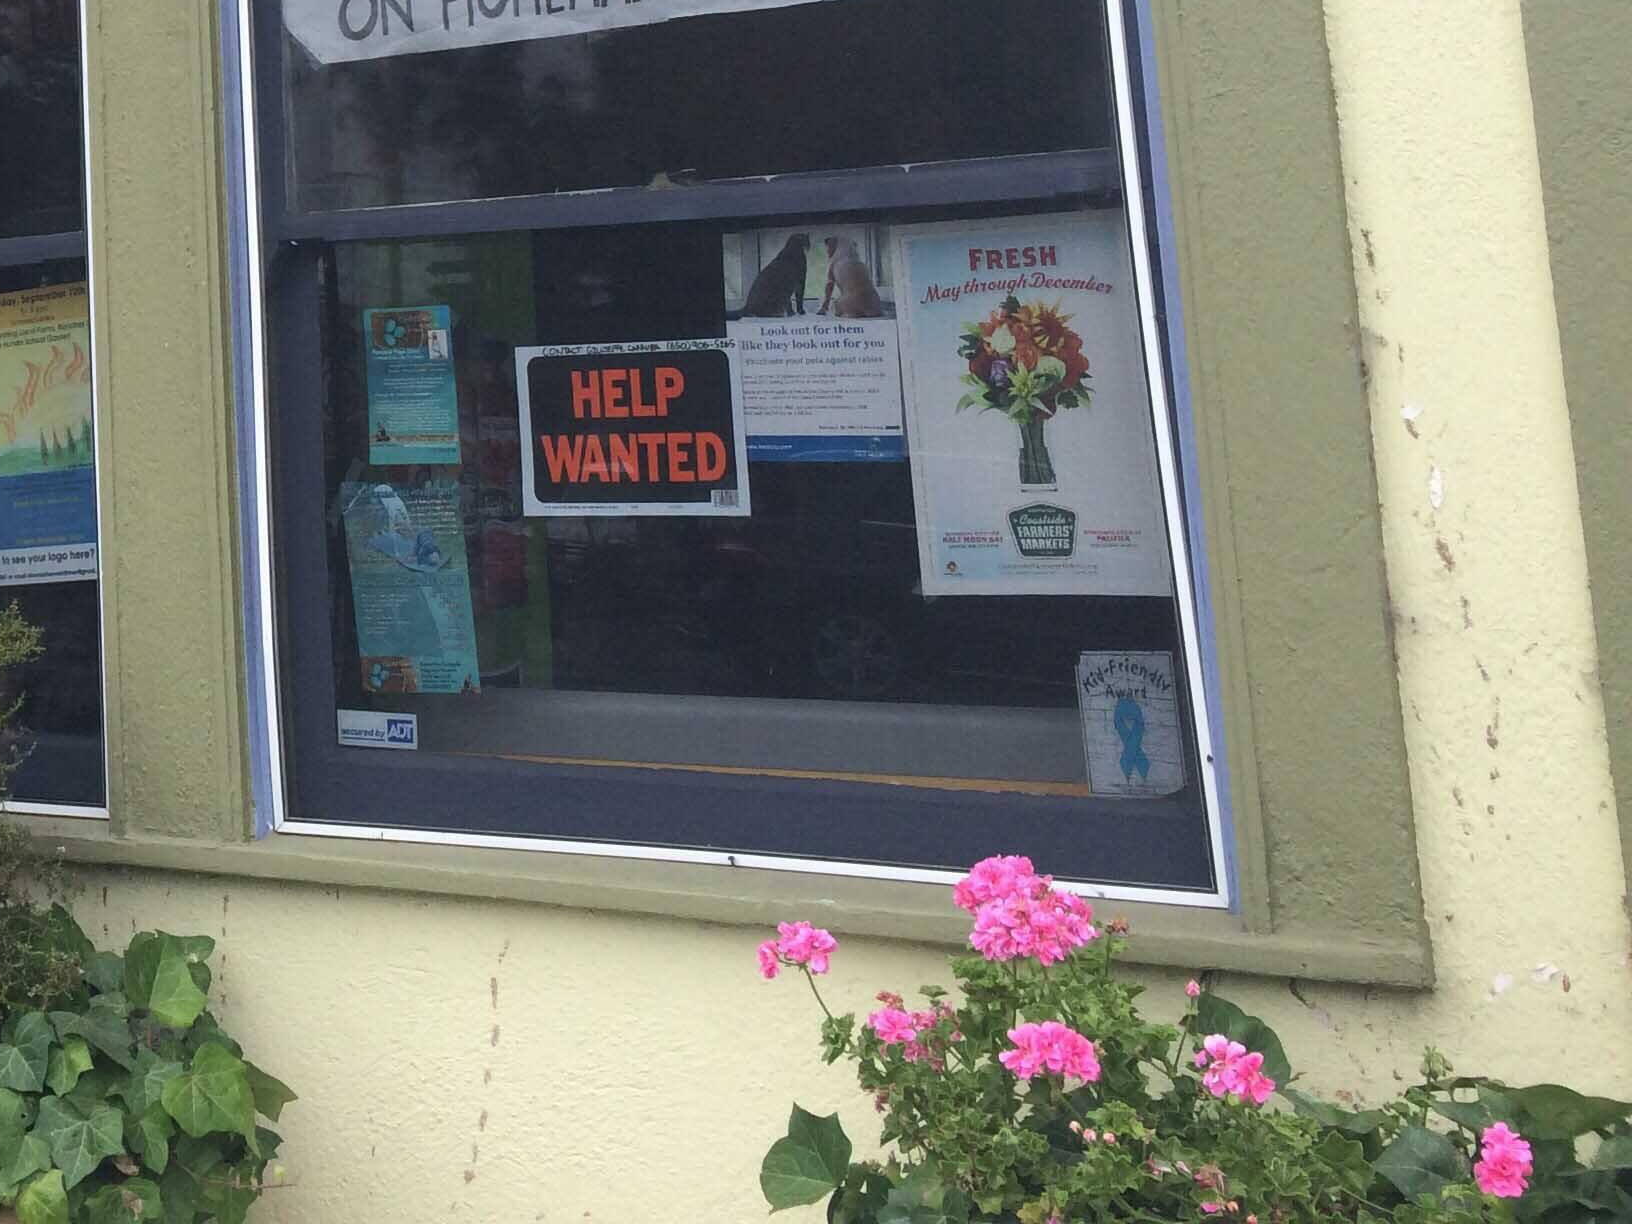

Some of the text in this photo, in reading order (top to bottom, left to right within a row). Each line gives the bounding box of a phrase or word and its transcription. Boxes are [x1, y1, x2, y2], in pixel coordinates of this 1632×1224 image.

[968, 246, 1057, 271] FRESH
[920, 272, 1113, 304] May through December
[760, 324, 865, 337] Look out for them
[742, 337, 885, 352] like they look out for you
[571, 367, 684, 418] HELP
[541, 432, 727, 483] WANTED
[1019, 514, 1067, 525] Coastside
[1021, 538, 1070, 551] MARKETS
[48, 552, 68, 563] logo
[69, 548, 95, 560] here?
[1082, 657, 1171, 693] Kid-Friendly
[388, 722, 412, 742] ADT
